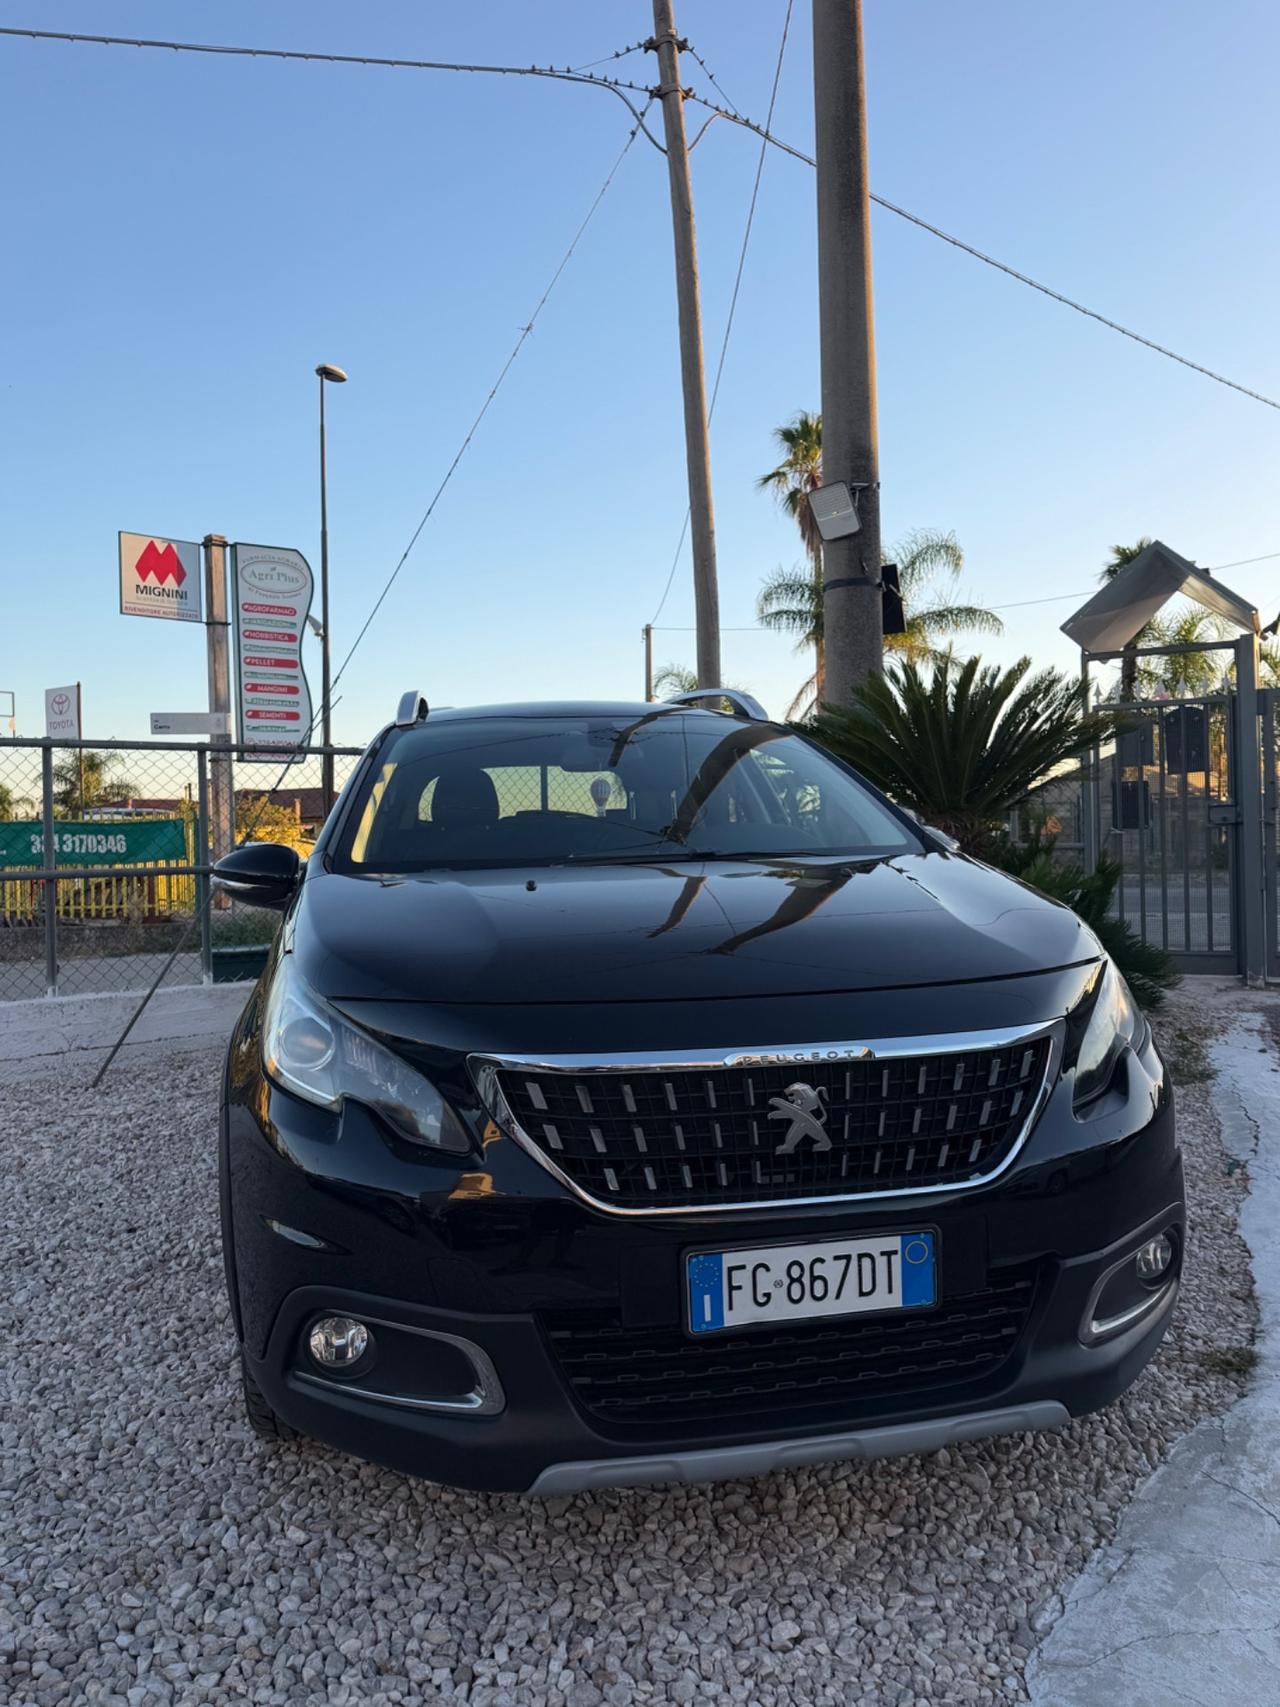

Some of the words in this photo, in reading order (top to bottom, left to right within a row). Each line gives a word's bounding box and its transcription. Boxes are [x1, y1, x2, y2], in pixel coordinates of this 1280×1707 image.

[249, 568, 274, 581] Agri
[277, 572, 300, 583] Plus
[135, 584, 188, 600] MIGNINI
[251, 658, 275, 666] PELLET
[258, 711, 287, 719] SEMENTI
[49, 720, 74, 730] TOYOTA
[31, 834, 60, 854] 34
[62, 834, 127, 854] 3170346
[743, 1050, 854, 1066] PEUGEOT
